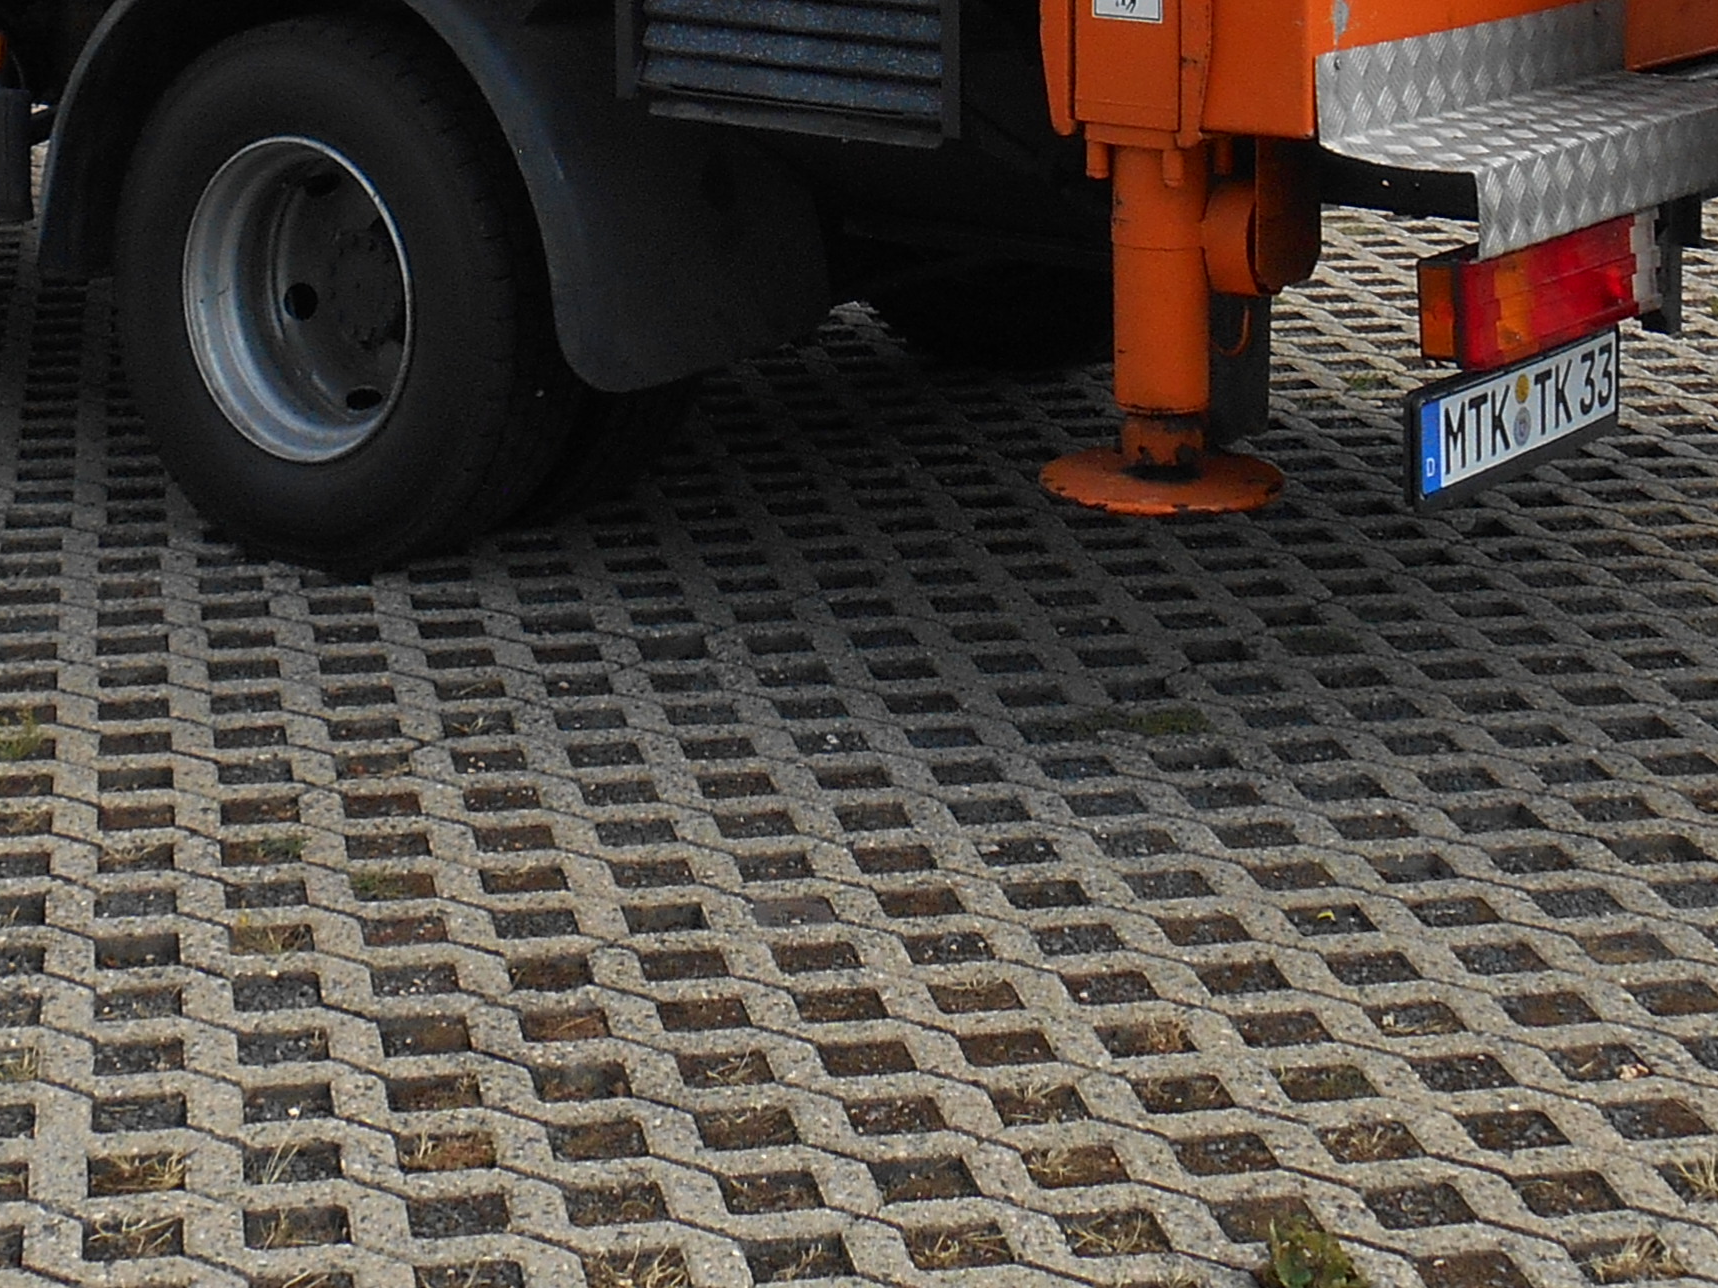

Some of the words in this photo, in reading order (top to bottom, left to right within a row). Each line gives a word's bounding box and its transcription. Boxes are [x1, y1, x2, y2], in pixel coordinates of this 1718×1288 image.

[1425, 456, 1436, 478] D
[1443, 384, 1511, 476] MTK
[1534, 358, 1573, 436] TK
[1579, 341, 1613, 416] 33
